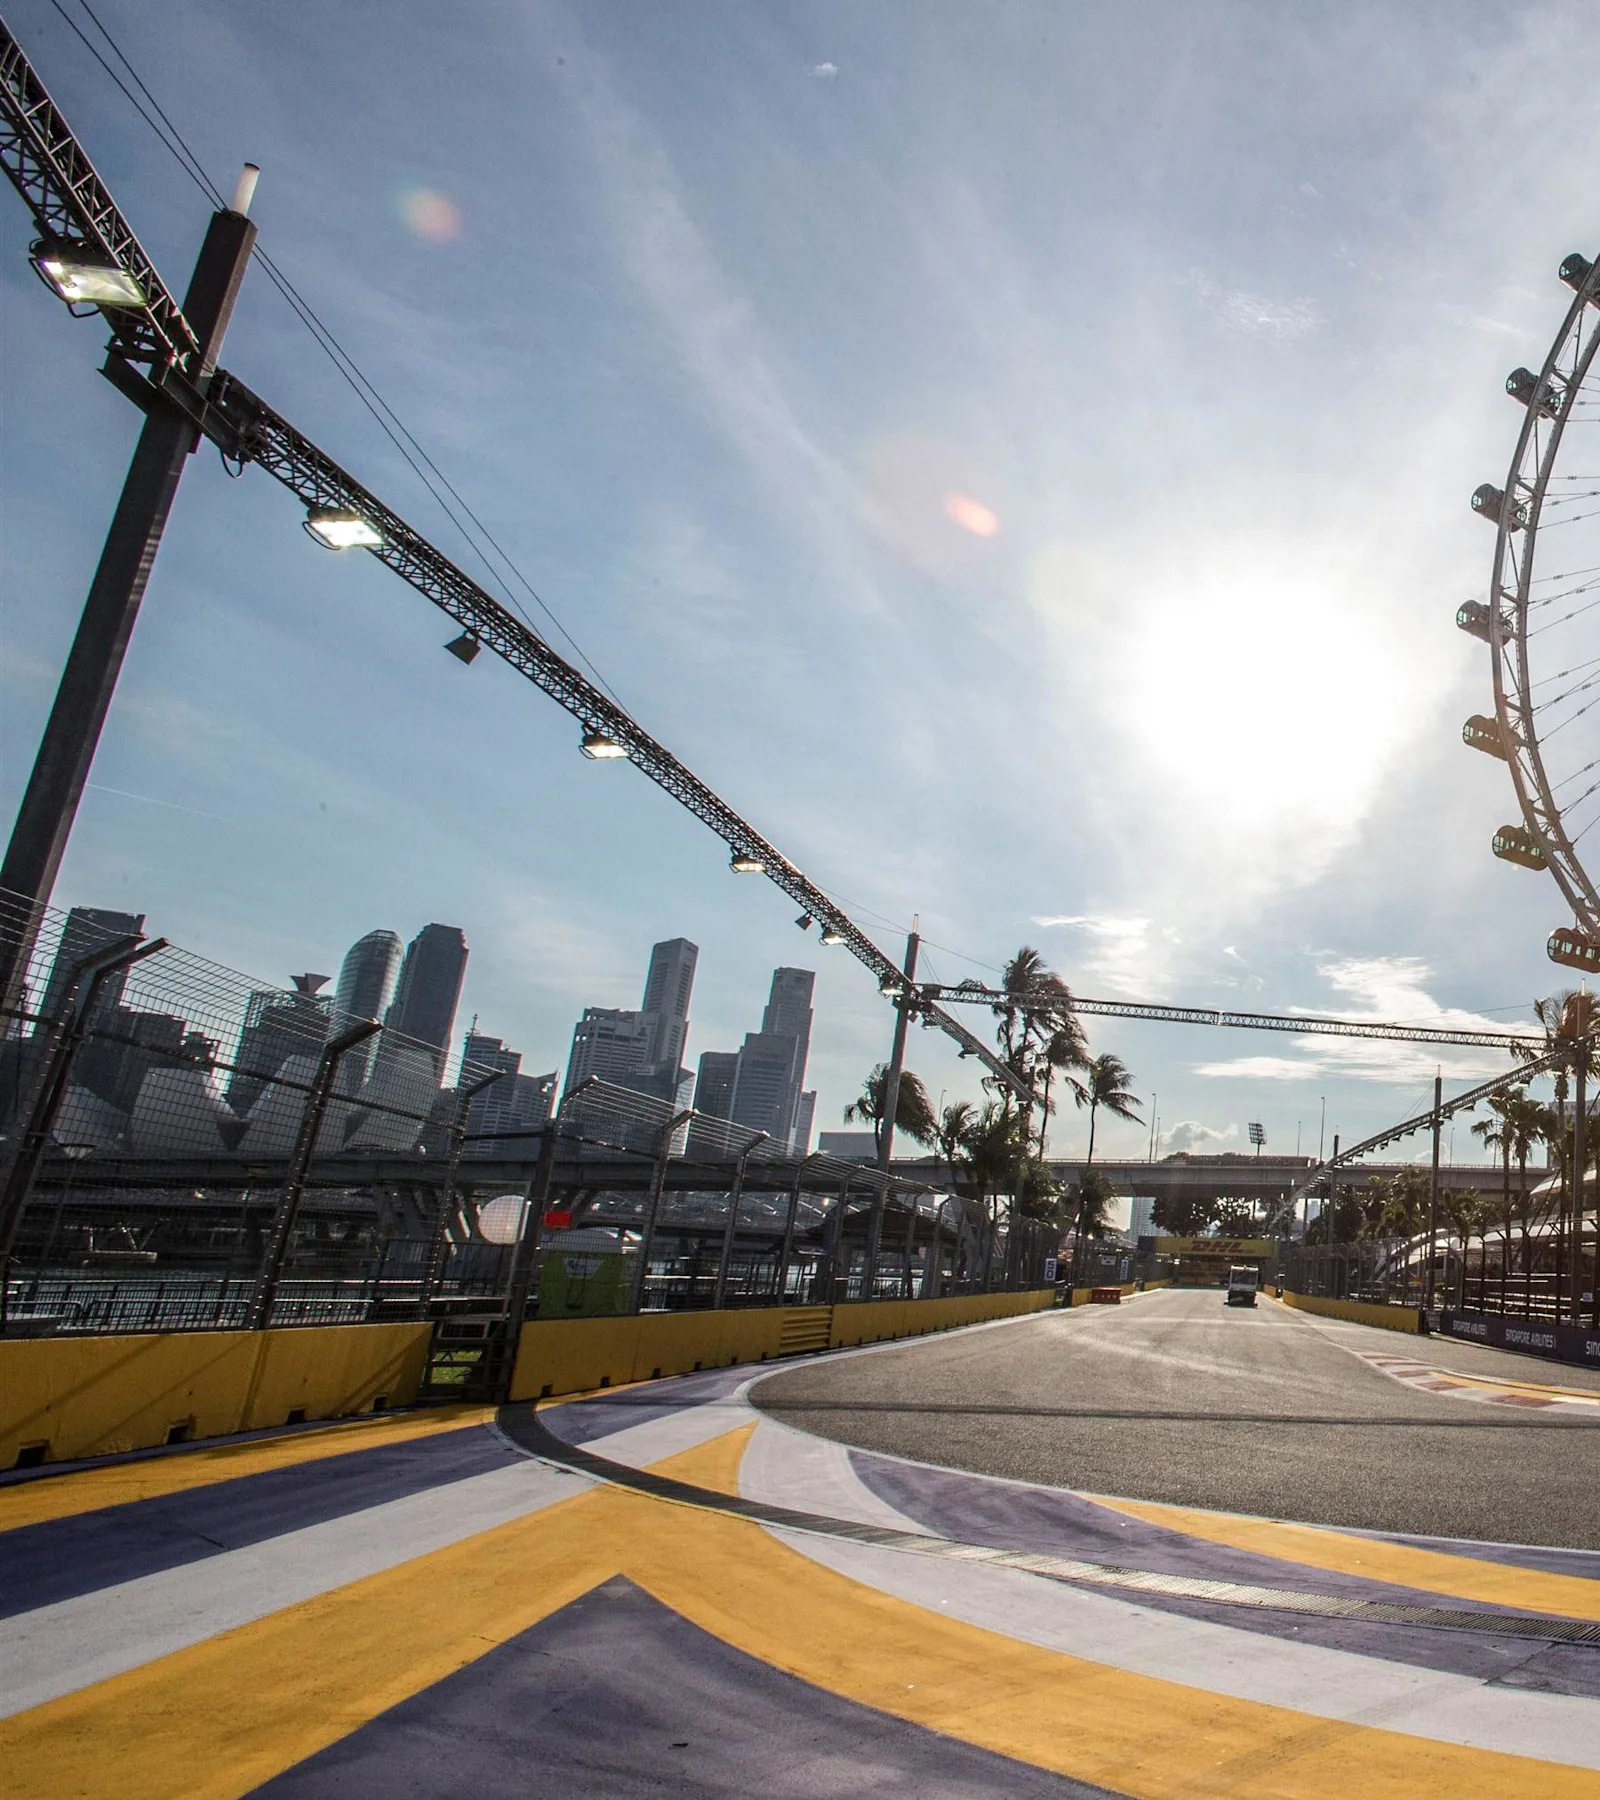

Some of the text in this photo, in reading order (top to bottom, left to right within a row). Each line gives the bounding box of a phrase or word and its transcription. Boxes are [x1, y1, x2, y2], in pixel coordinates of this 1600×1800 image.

[1191, 1240, 1245, 1253] DHL
[1047, 1260, 1055, 1279] 50
[1505, 1328, 1553, 1348] SINGAPORE AIRLINES
